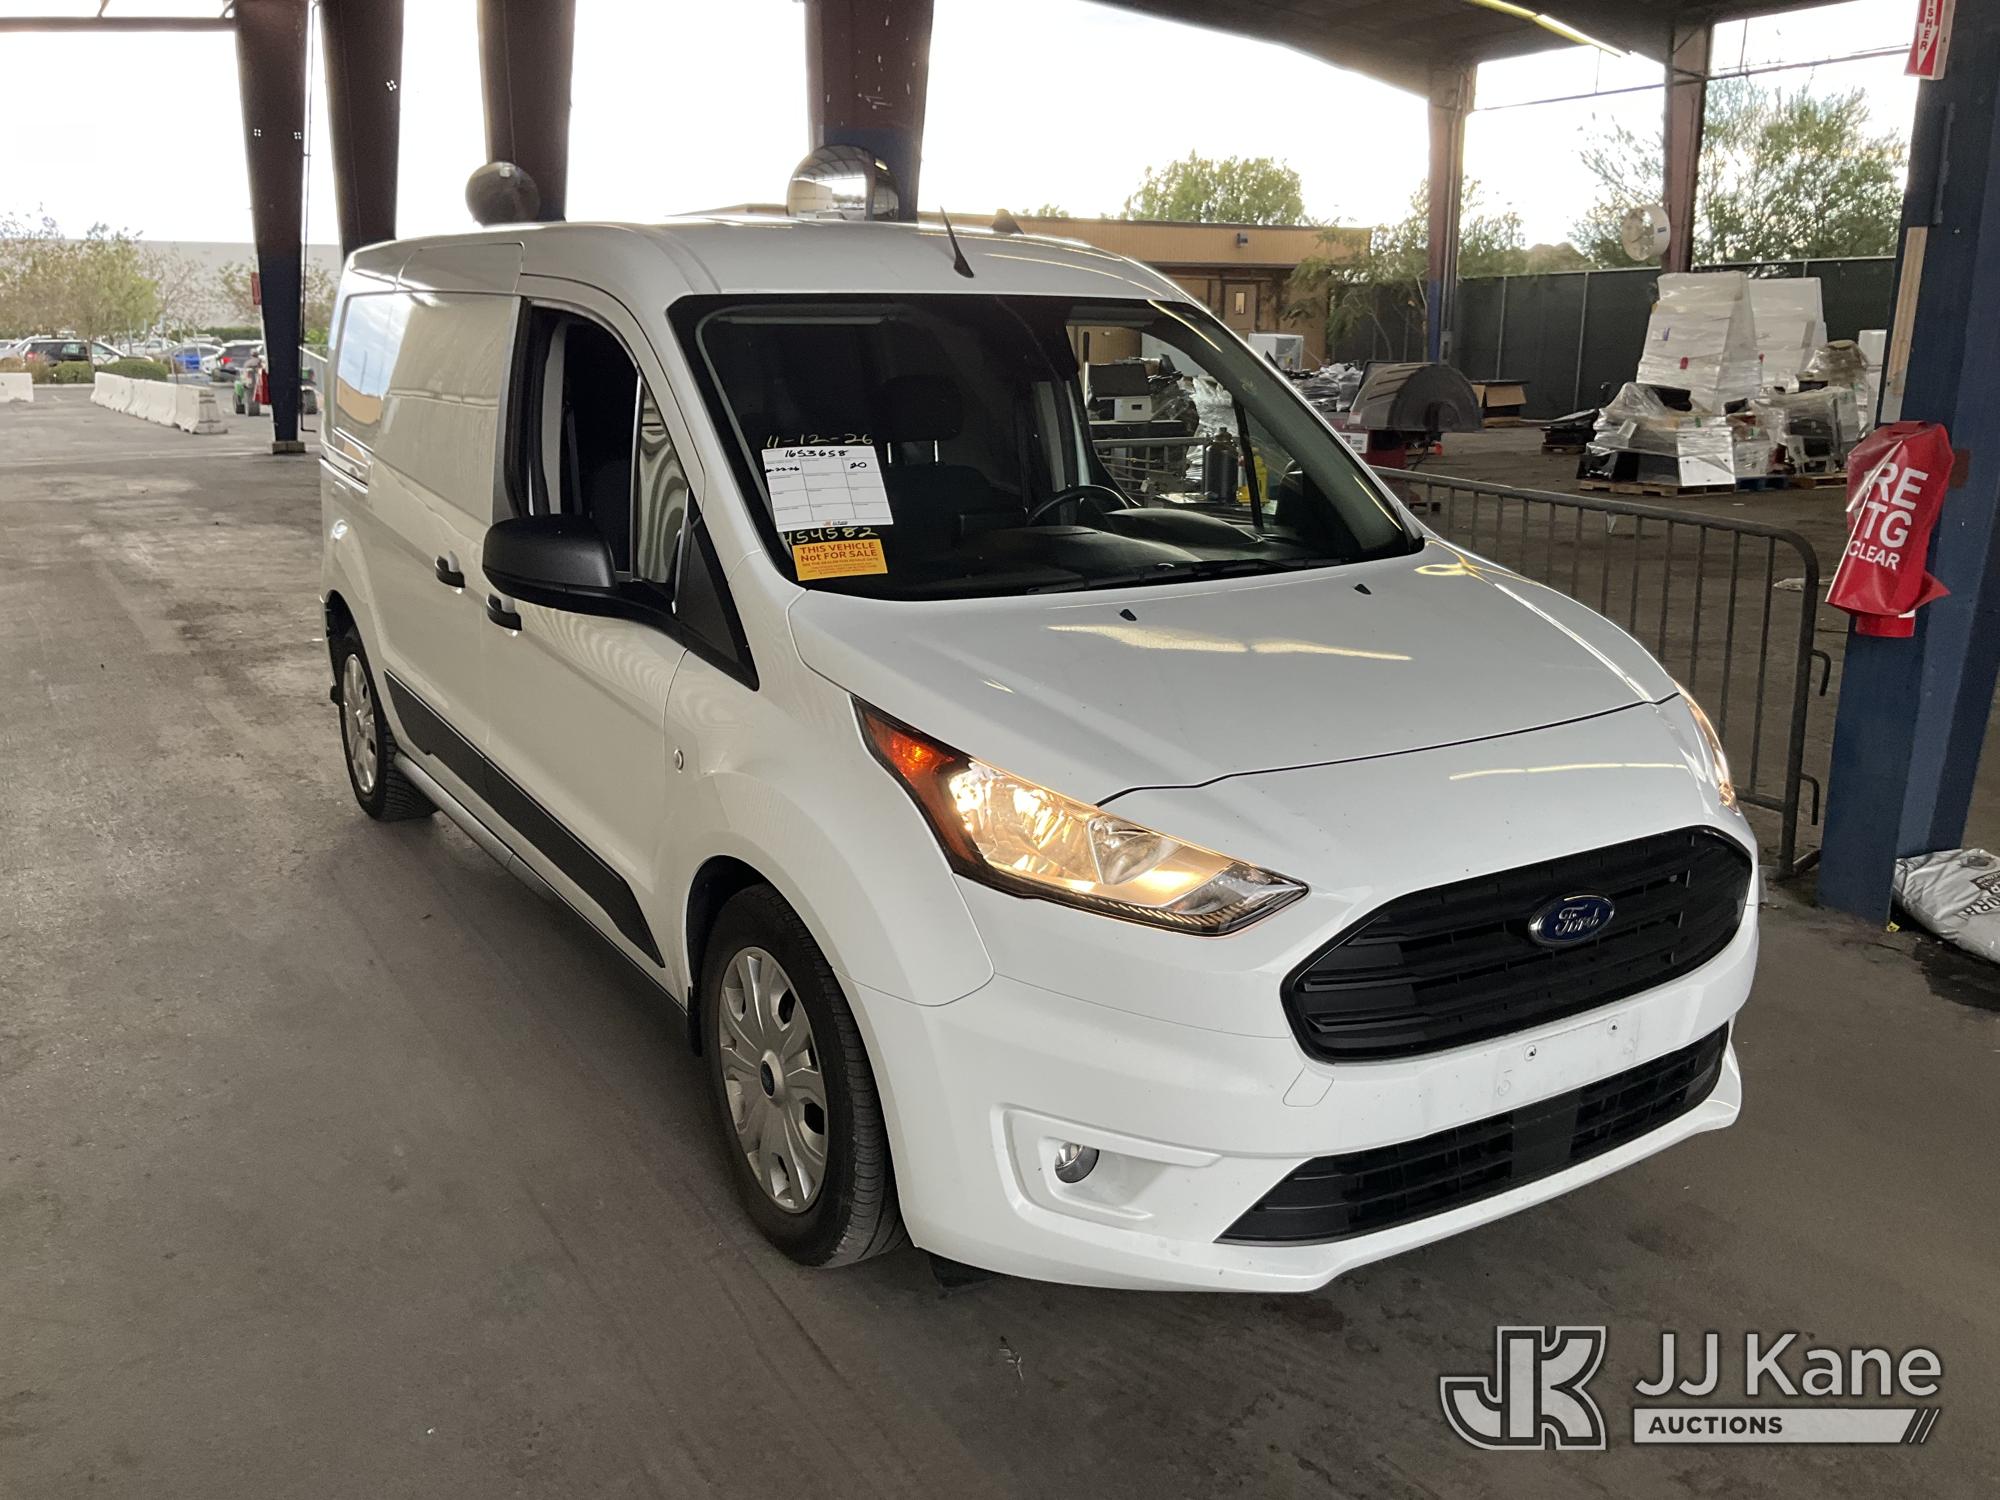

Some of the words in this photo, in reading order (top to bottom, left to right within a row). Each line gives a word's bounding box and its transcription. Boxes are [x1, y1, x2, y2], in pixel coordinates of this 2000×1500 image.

[766, 433, 873, 449] 11-12-26
[800, 545, 826, 554] THIS
[828, 541, 875, 551] VEHICLE
[1848, 541, 1900, 570] CLEAR
[800, 554, 822, 562] Not
[824, 551, 847, 560] FOR
[849, 550, 877, 558] SALE
[1555, 904, 1600, 936] Ford
